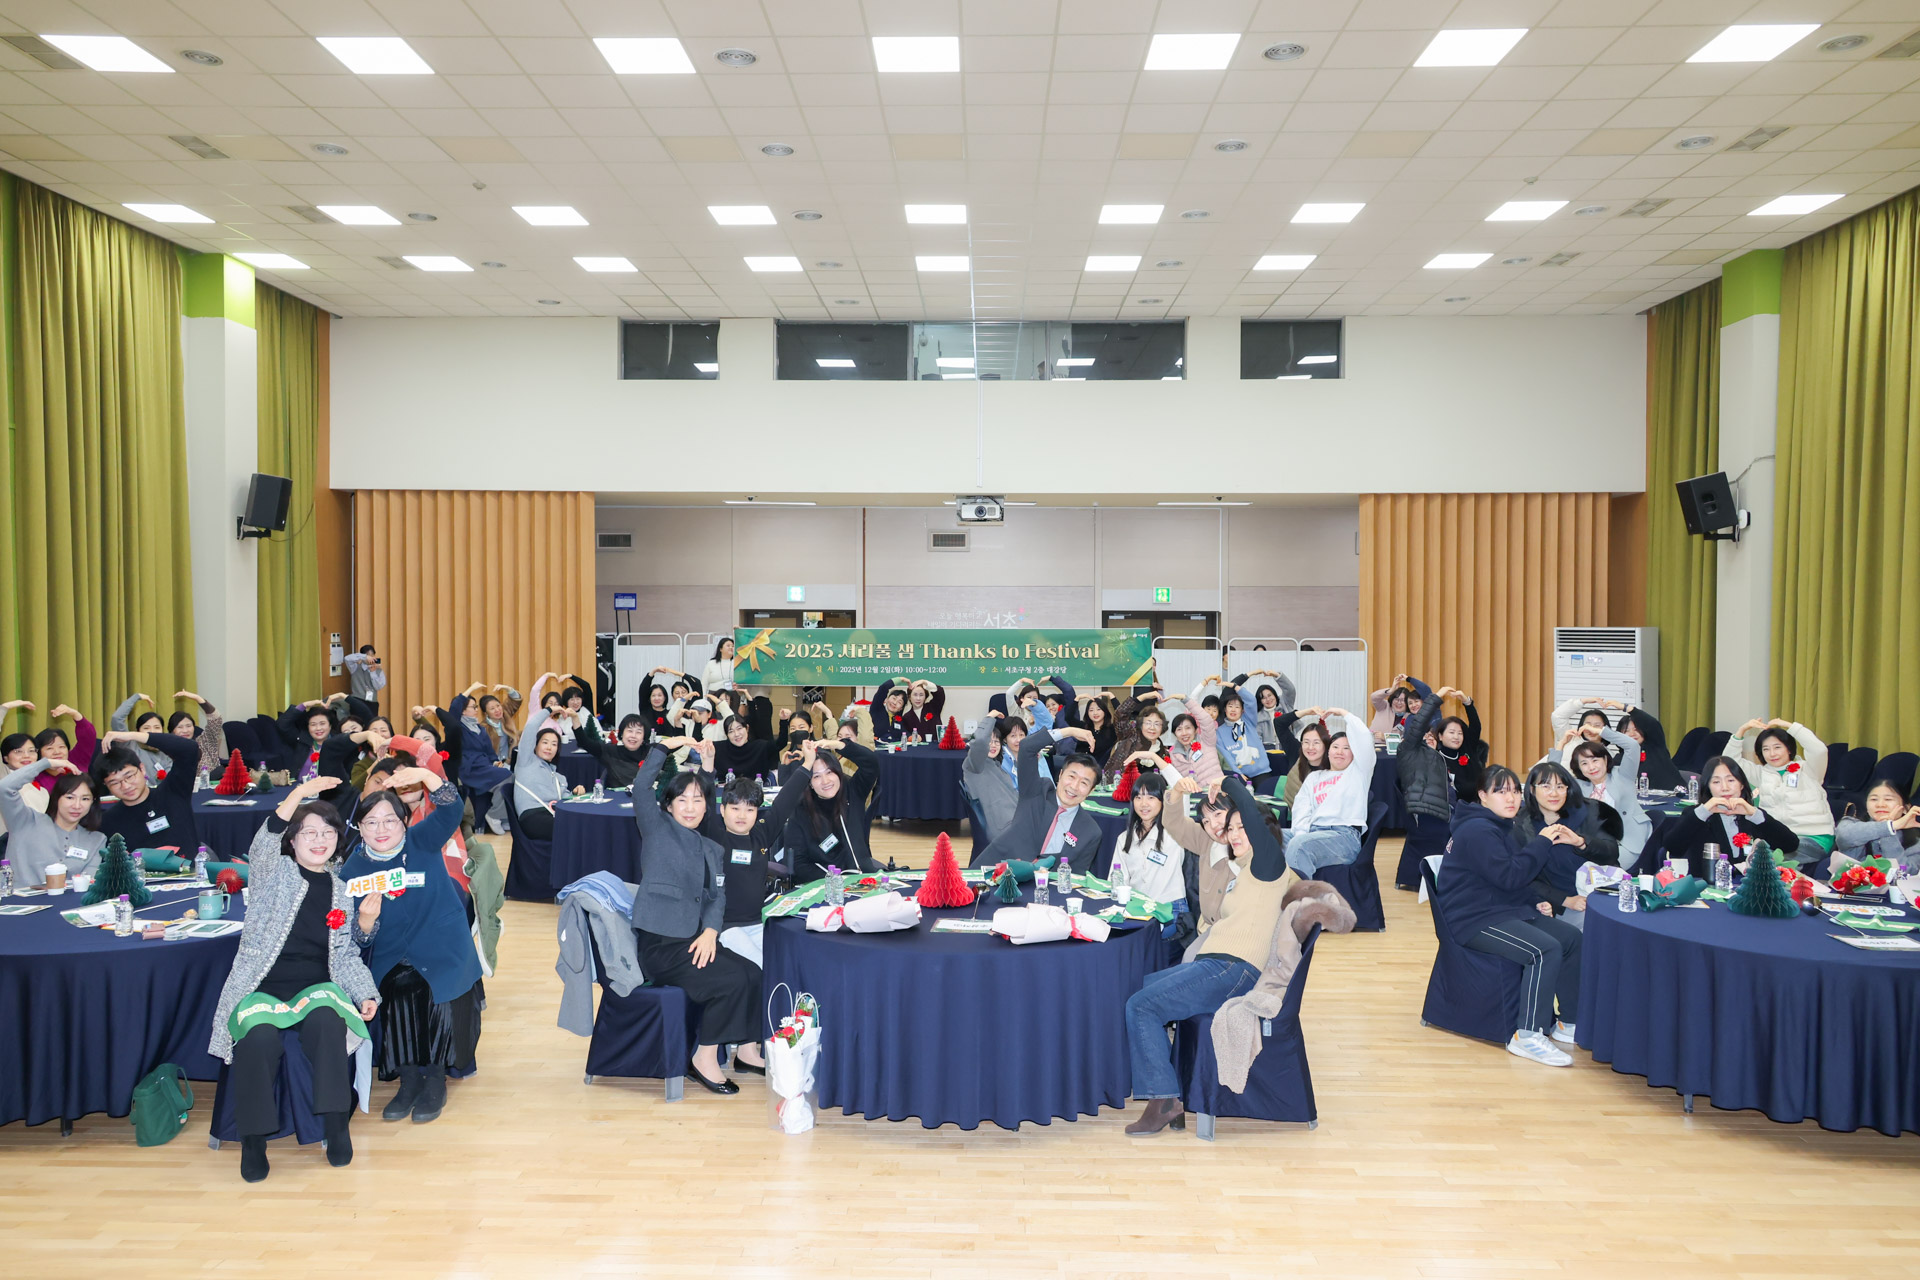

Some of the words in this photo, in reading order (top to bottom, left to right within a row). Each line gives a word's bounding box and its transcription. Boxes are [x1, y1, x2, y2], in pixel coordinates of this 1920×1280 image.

[983, 611, 1018, 628] 서초
[784, 643, 834, 658] 2025
[838, 643, 891, 659] 서리풀
[897, 643, 915, 659] 샘
[919, 643, 997, 659] Thanks
[1002, 644, 1020, 659] to
[1024, 642, 1100, 659] Festival
[839, 665, 862, 674] 2025년
[864, 665, 879, 674] 12월
[880, 665, 904, 674] 2일(화)
[905, 665, 947, 674] 10:00~12:00
[1004, 665, 1032, 674] 서초구청
[1033, 665, 1045, 674] 2층
[1046, 665, 1067, 674] 대강당
[349, 873, 387, 894] 서리풀
[389, 871, 403, 888] 샘
